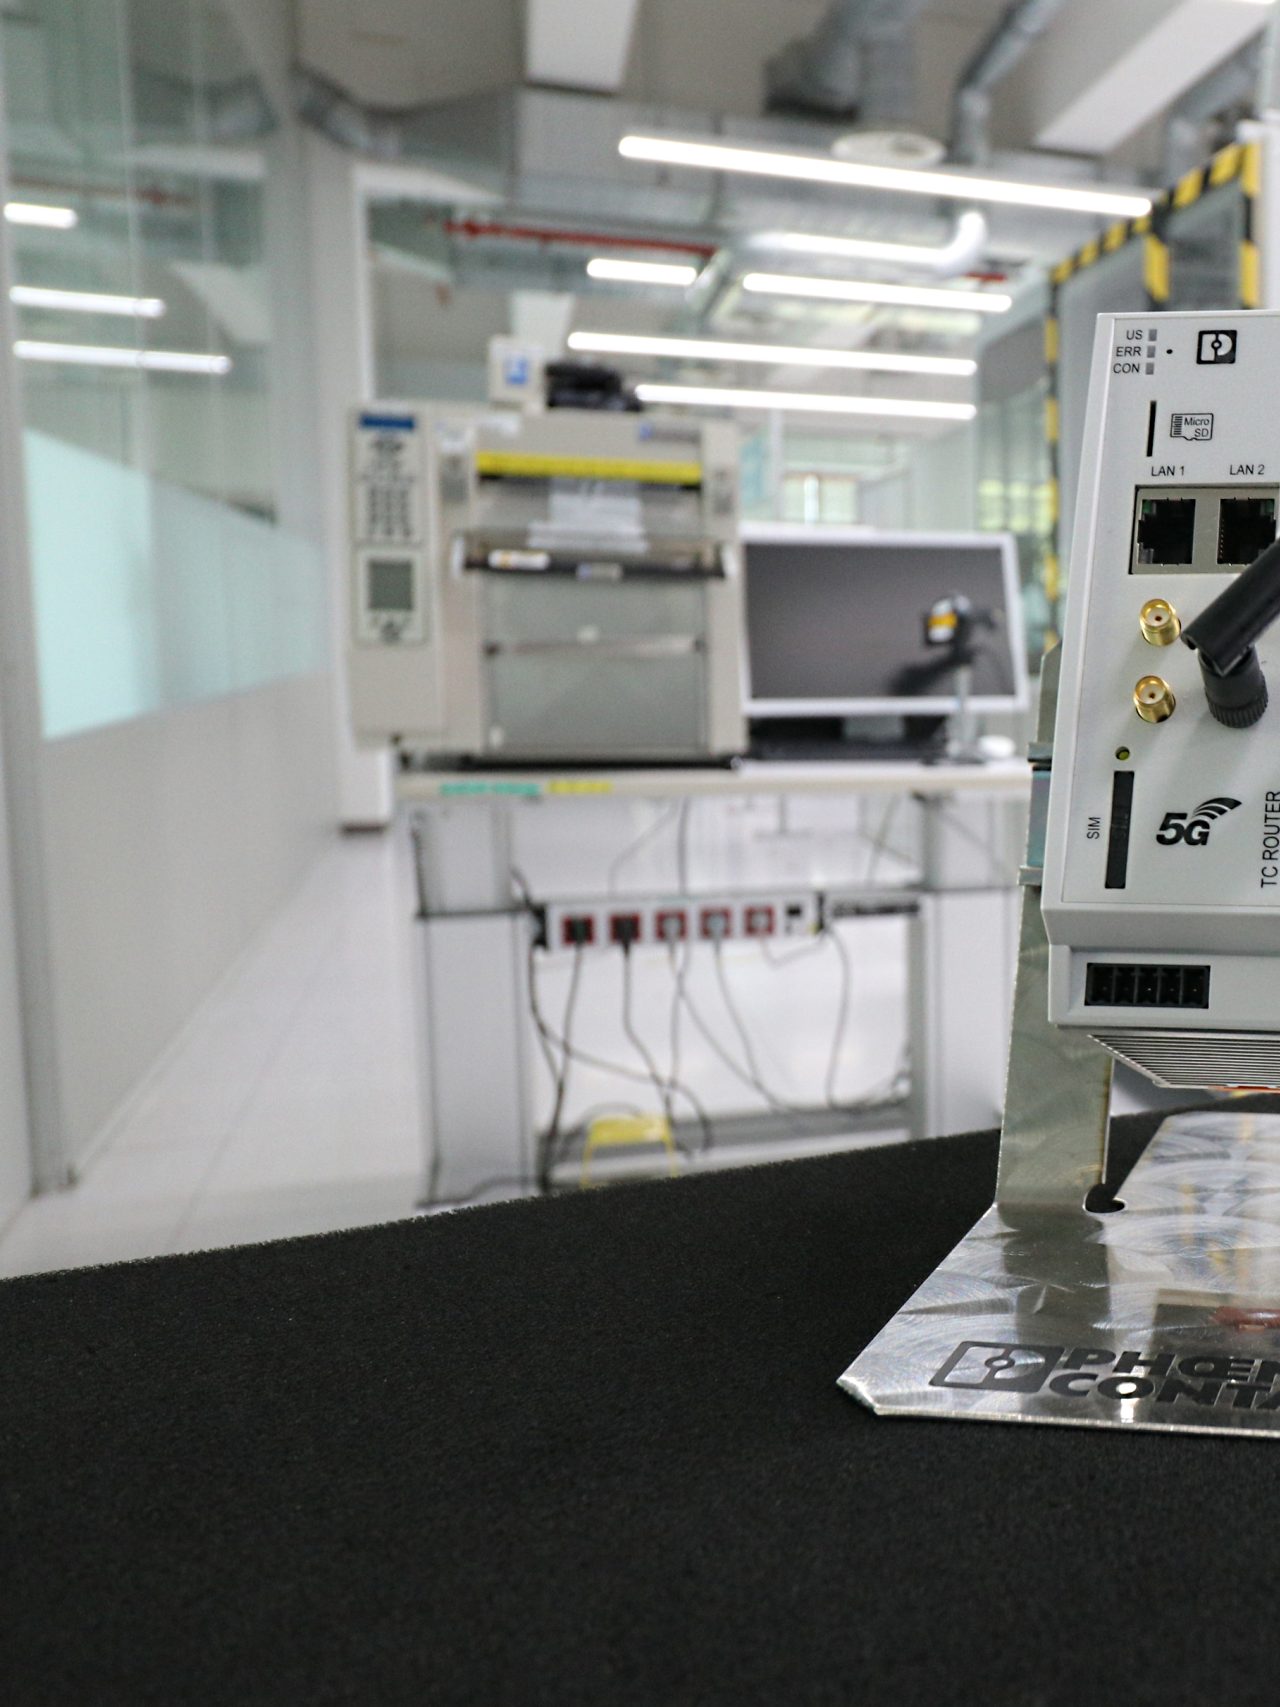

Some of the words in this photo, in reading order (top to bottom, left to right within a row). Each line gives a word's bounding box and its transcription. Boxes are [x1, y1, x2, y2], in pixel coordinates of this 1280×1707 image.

[1126, 329, 1143, 340] US
[1115, 346, 1142, 357] ERR
[1113, 362, 1140, 373] CON
[1184, 417, 1210, 426] Micro
[1194, 428, 1209, 437] SD
[1151, 465, 1176, 477] LAN
[1229, 464, 1255, 476] LAN
[1258, 464, 1265, 475] 2
[1087, 816, 1101, 840] SIM
[1156, 812, 1211, 846] 5G
[1260, 866, 1278, 889] TC
